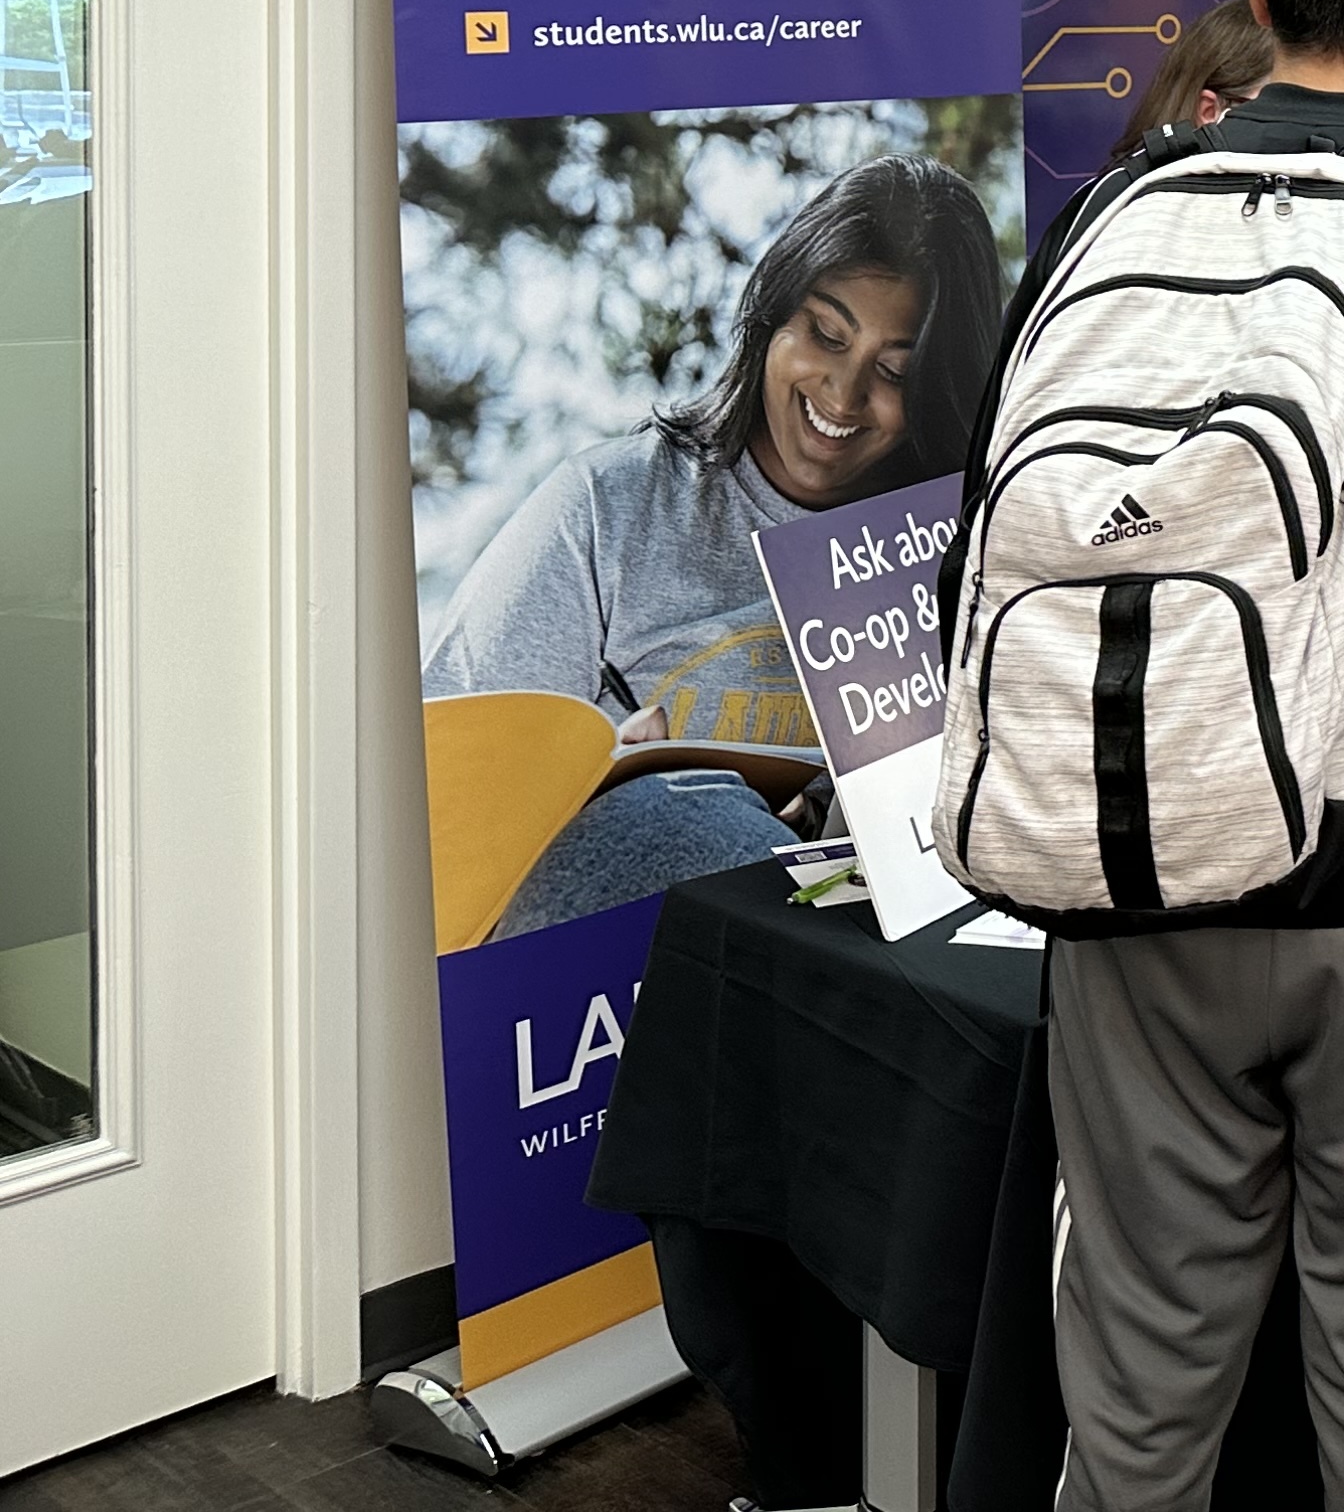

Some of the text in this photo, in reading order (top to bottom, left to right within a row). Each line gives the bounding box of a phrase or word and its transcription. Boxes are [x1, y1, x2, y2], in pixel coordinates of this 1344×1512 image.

[533, 15, 862, 47] students.wlu.ca/career
[829, 525, 895, 589] Ask
[1091, 520, 1164, 546] adidas
[799, 583, 940, 671] Co-op &
